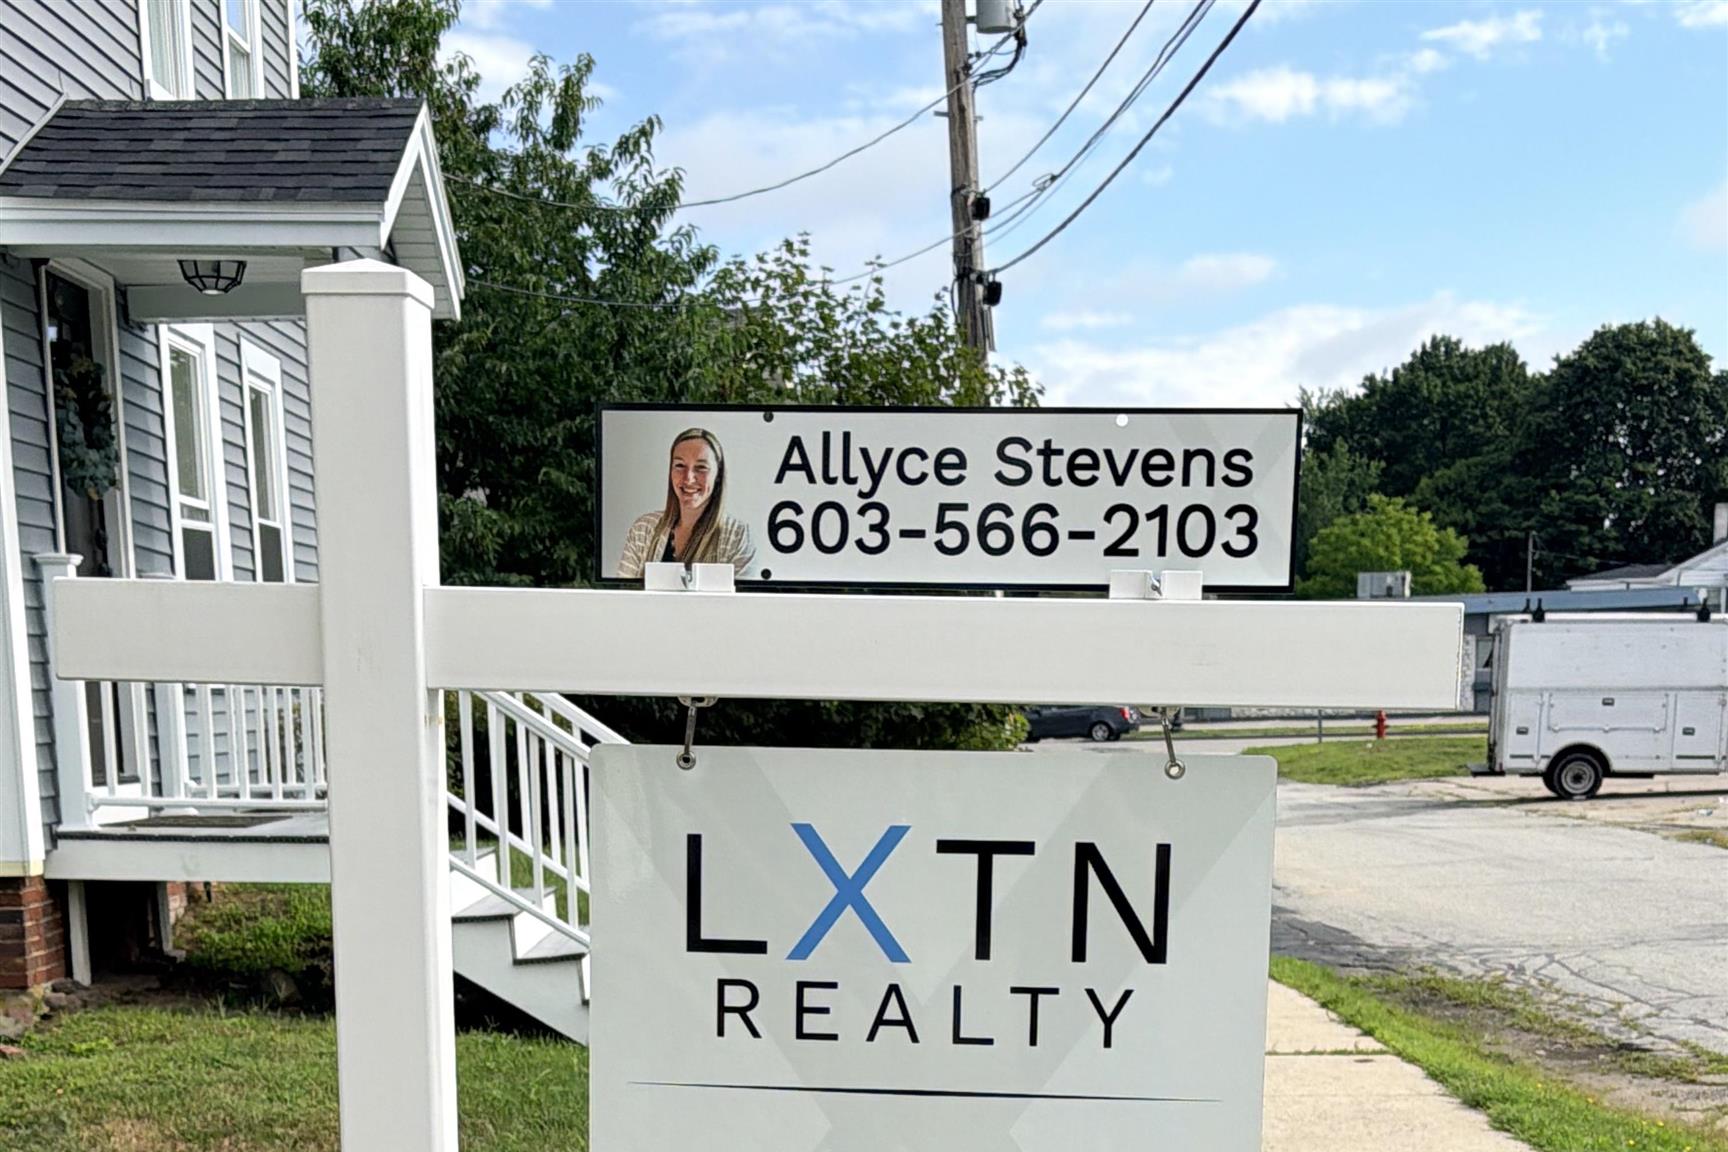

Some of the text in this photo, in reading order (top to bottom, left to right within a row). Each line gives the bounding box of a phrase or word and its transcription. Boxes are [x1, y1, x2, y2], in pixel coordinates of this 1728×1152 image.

[774, 430, 1254, 499] Allyce Stevens
[767, 501, 1258, 558] 603-566-2103
[686, 823, 1171, 965] LXTN
[716, 977, 1134, 1048] REALTY
